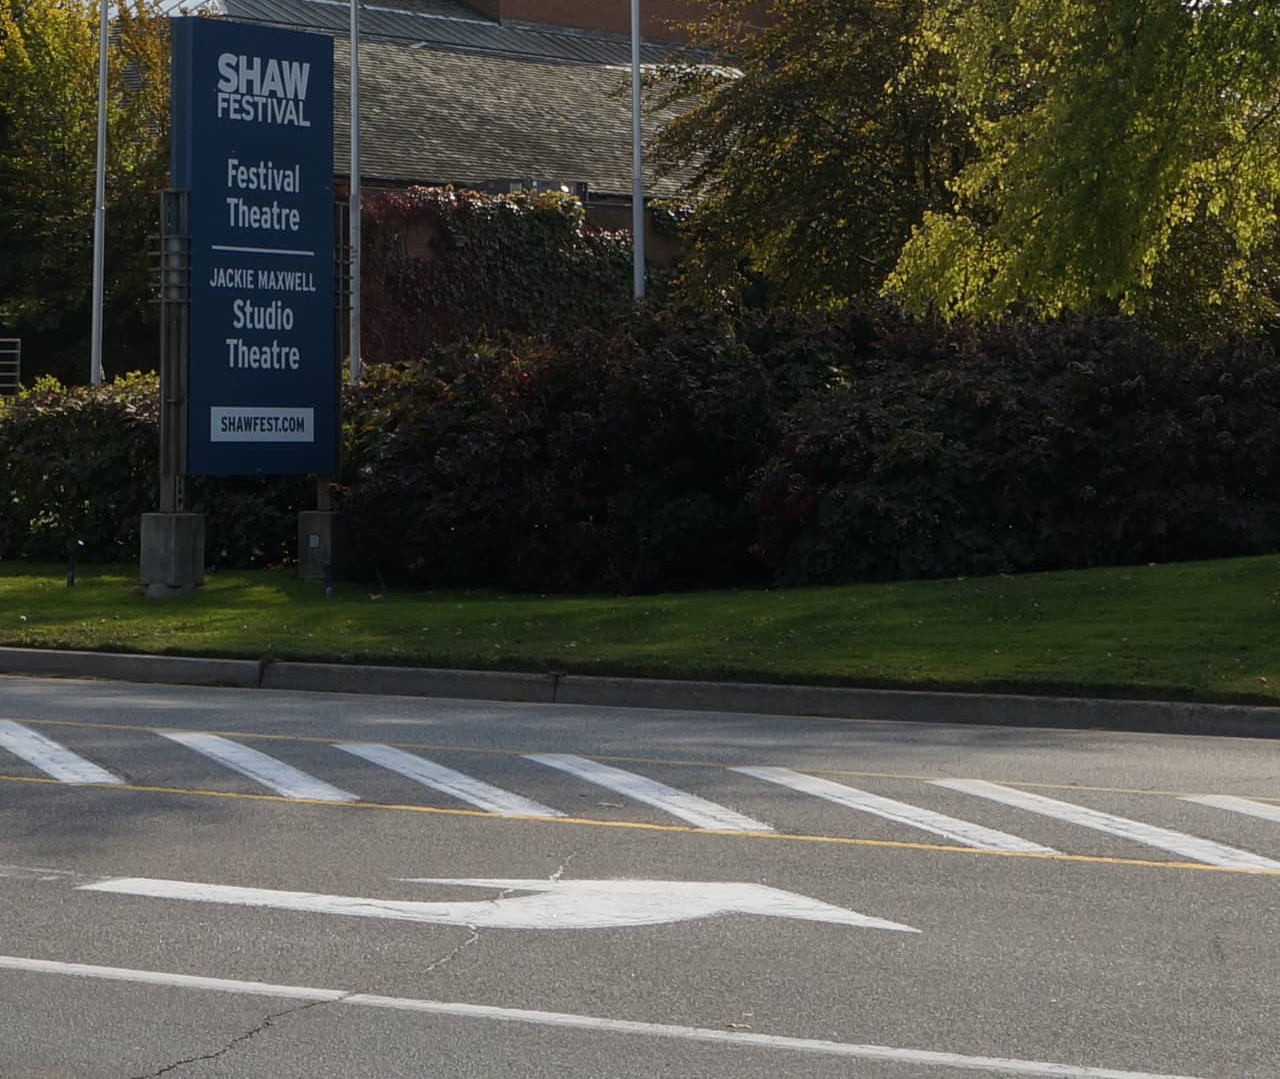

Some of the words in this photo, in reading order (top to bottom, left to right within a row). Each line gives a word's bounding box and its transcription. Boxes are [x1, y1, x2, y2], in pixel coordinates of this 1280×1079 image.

[217, 53, 311, 100] SHAW
[217, 92, 311, 127] FESTIVAL
[227, 158, 300, 193] Festival
[226, 197, 300, 231] Theatre
[210, 268, 254, 289] JACKIE
[258, 270, 316, 291] MAXWELL
[233, 299, 294, 330] Studio
[226, 338, 300, 369] Theatre
[221, 416, 305, 433] SHAWFEST.COM
